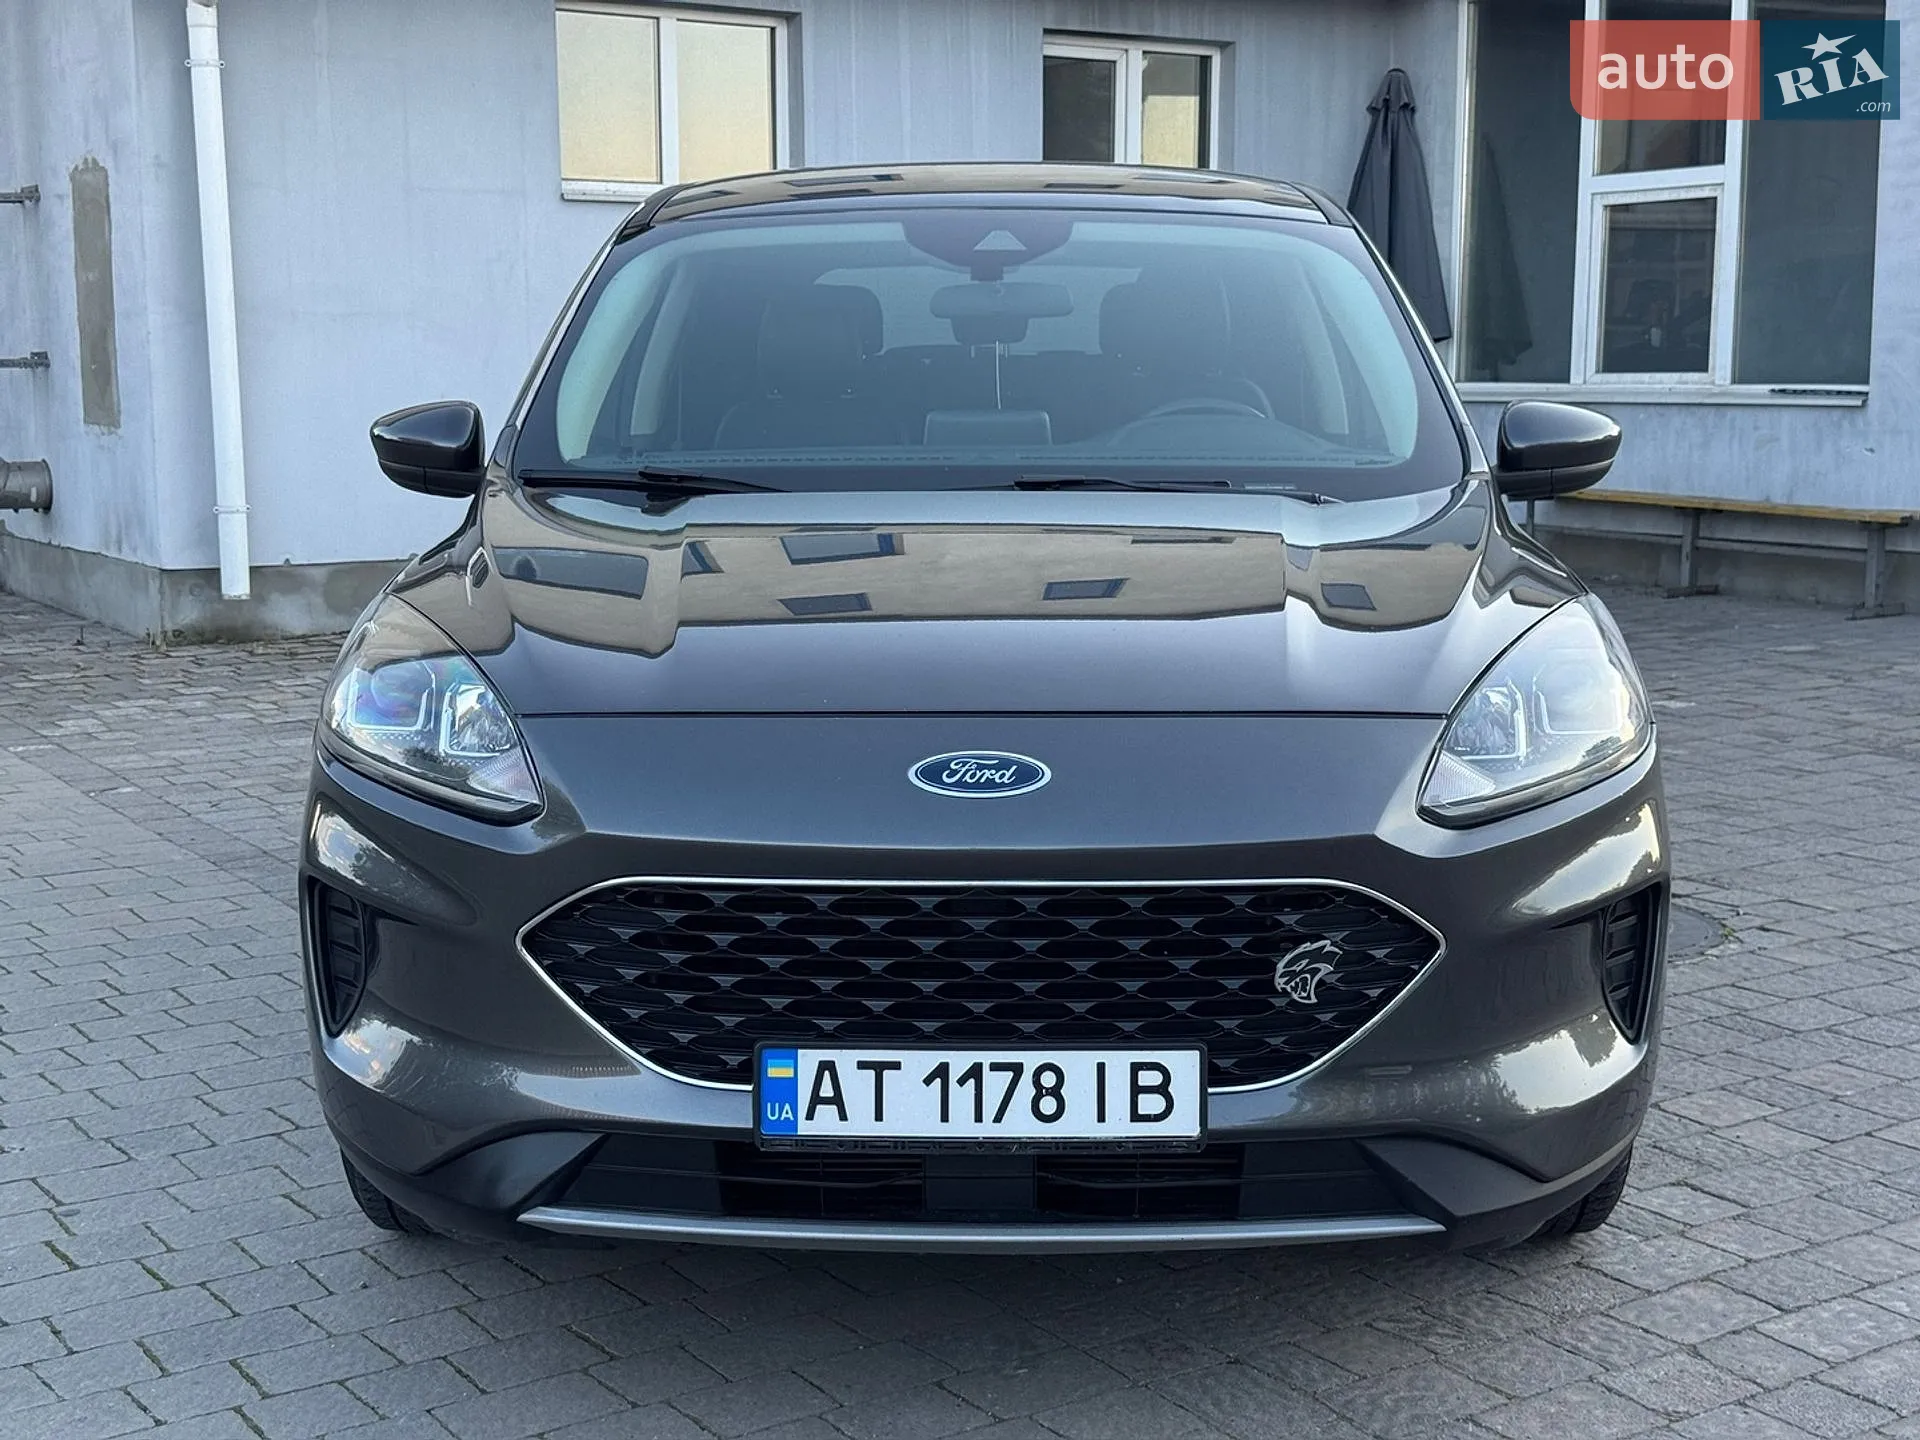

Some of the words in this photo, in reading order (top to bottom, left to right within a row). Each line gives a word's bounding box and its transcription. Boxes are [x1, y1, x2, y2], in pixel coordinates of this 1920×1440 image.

[941, 758, 1018, 784] Ford
[804, 1060, 902, 1122] AT
[922, 1061, 1066, 1124] 1178
[1096, 1061, 1175, 1123] IB
[766, 1102, 794, 1121] UA
